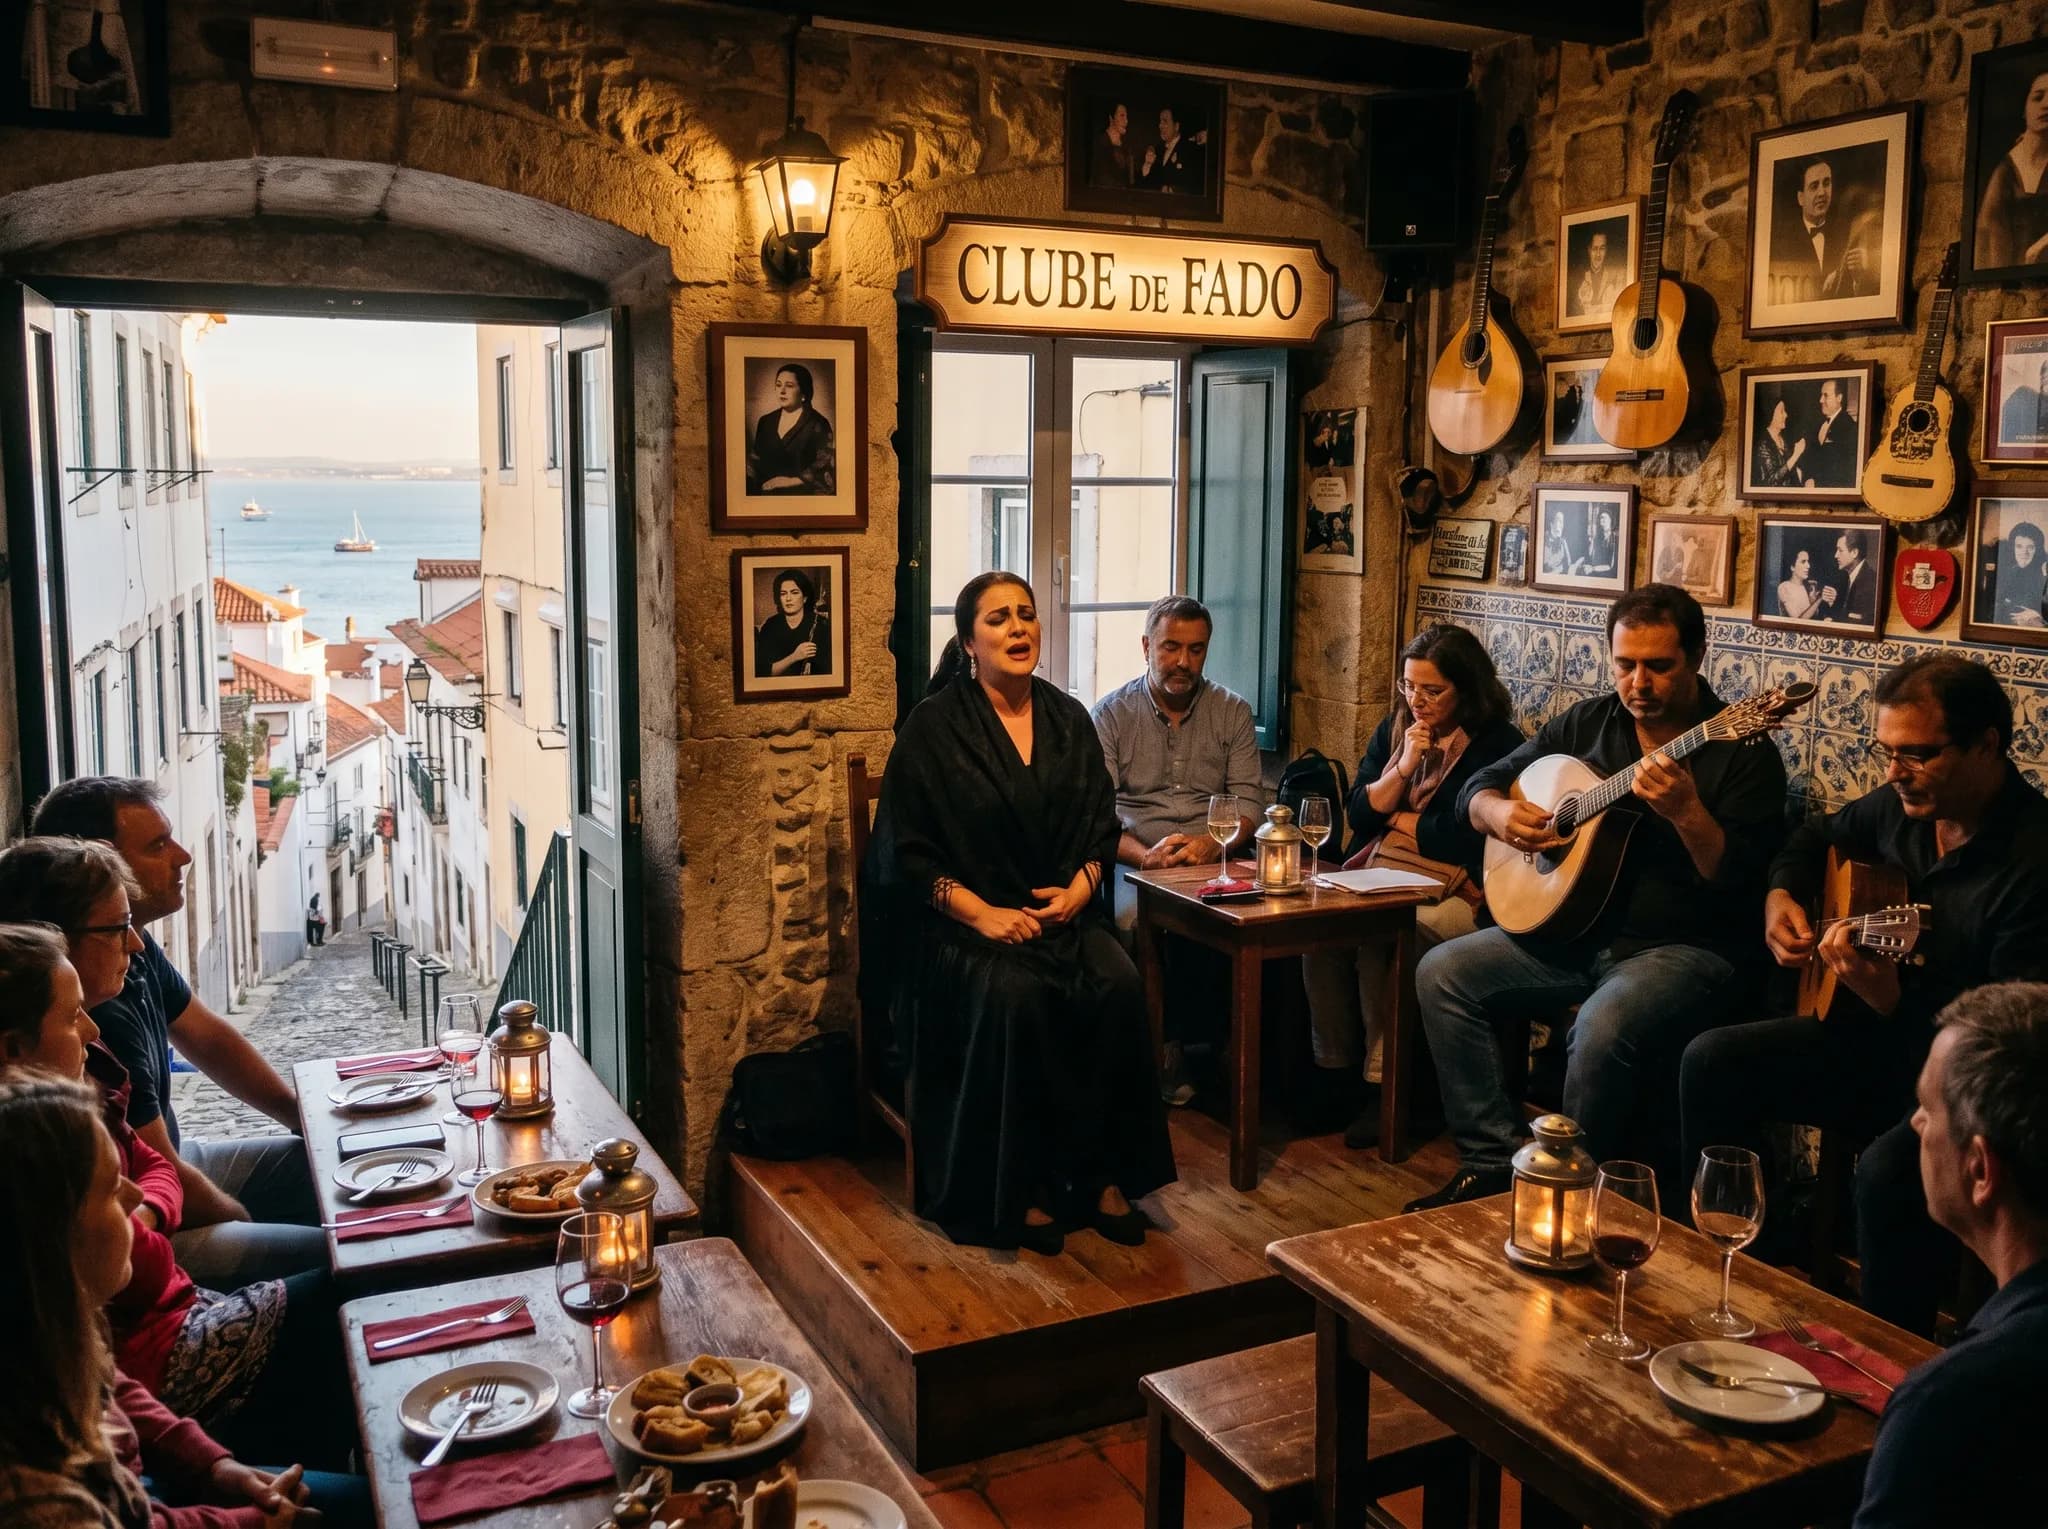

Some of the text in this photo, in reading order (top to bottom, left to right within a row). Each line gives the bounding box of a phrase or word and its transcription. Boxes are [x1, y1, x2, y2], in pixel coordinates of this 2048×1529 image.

[958, 243, 1303, 321] CLUBE DE FADO
